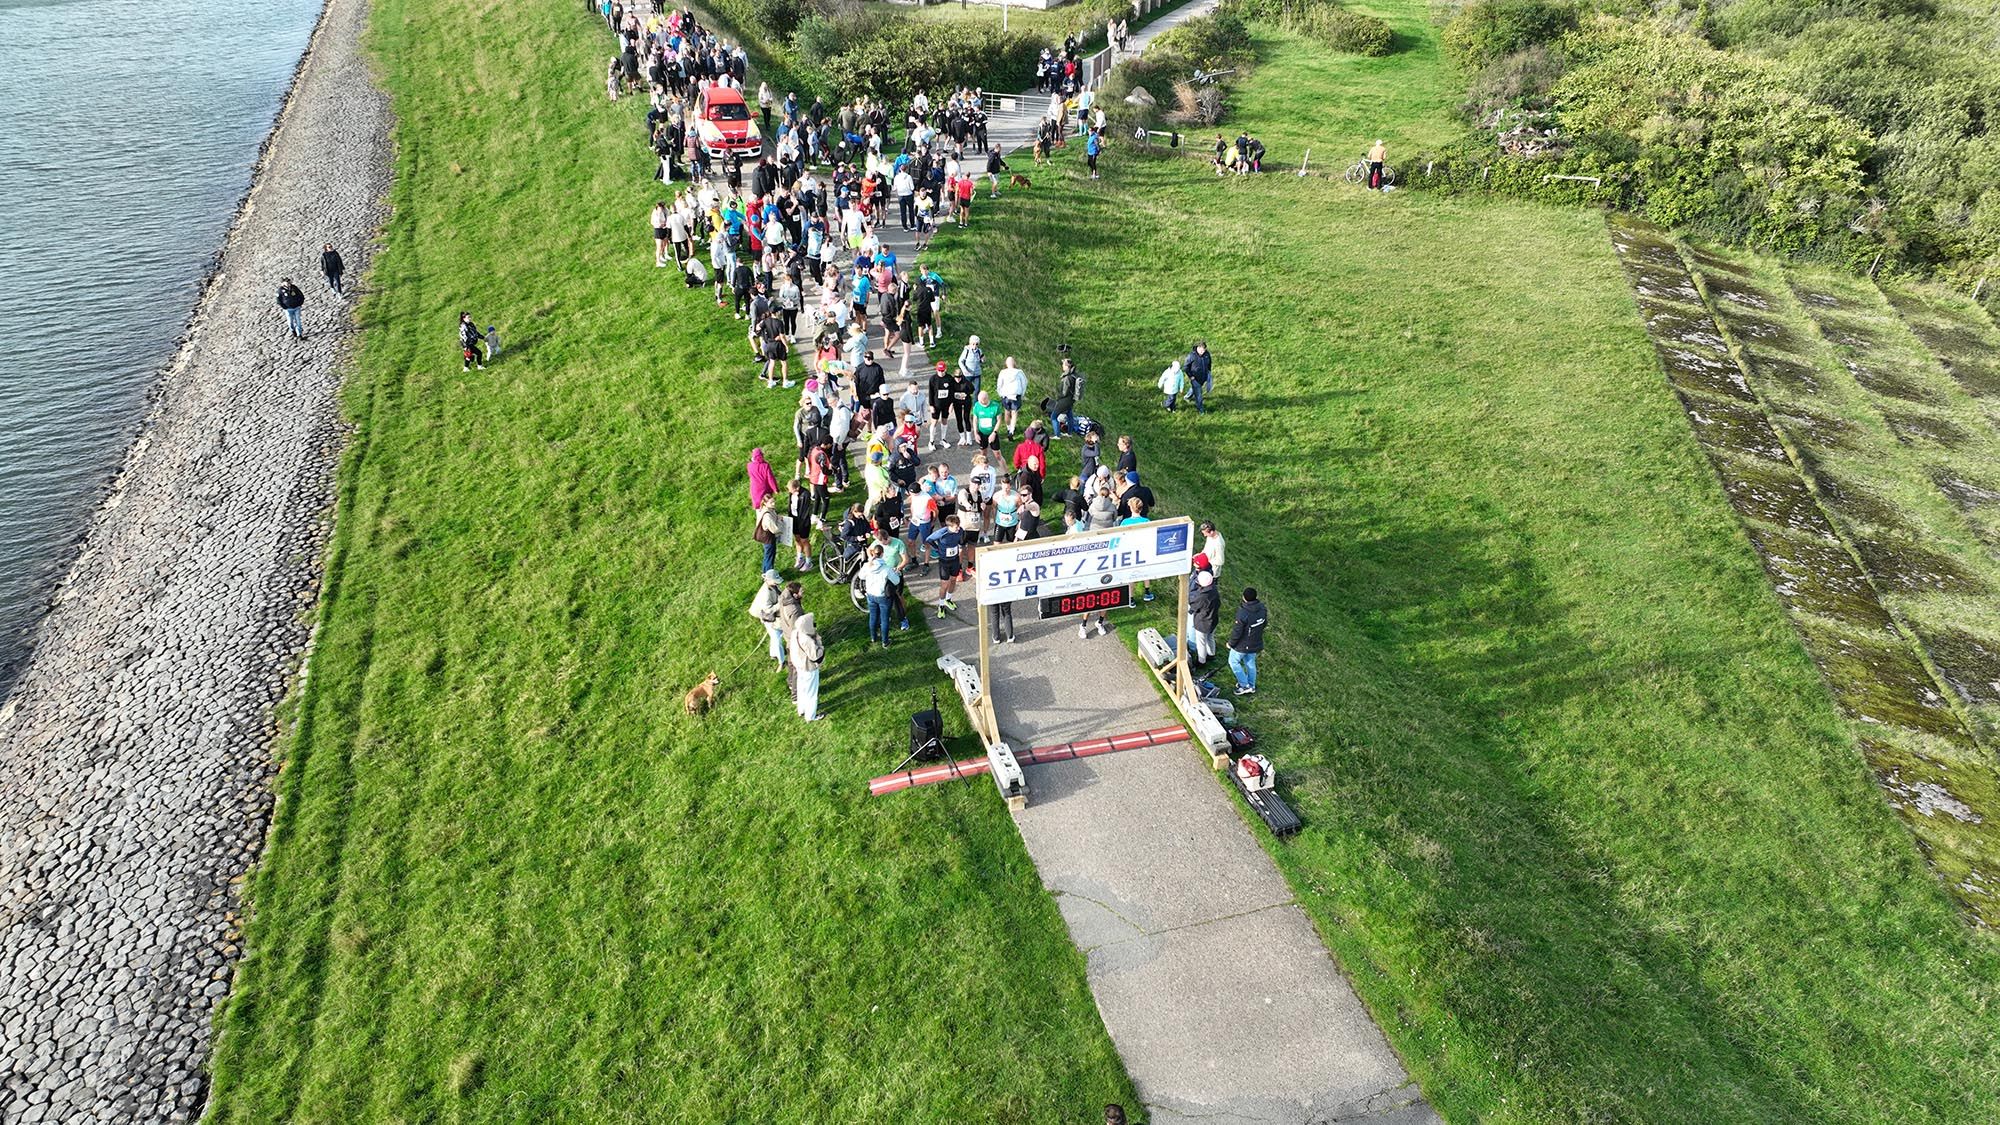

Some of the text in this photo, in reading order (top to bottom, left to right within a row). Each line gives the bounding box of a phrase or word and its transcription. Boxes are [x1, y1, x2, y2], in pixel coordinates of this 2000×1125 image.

[1017, 541, 1109, 561] RUN UMS RANTUMBECKEN
[988, 549, 1146, 587] START / ZIEL
[1061, 590, 1120, 613] 0:00:00
